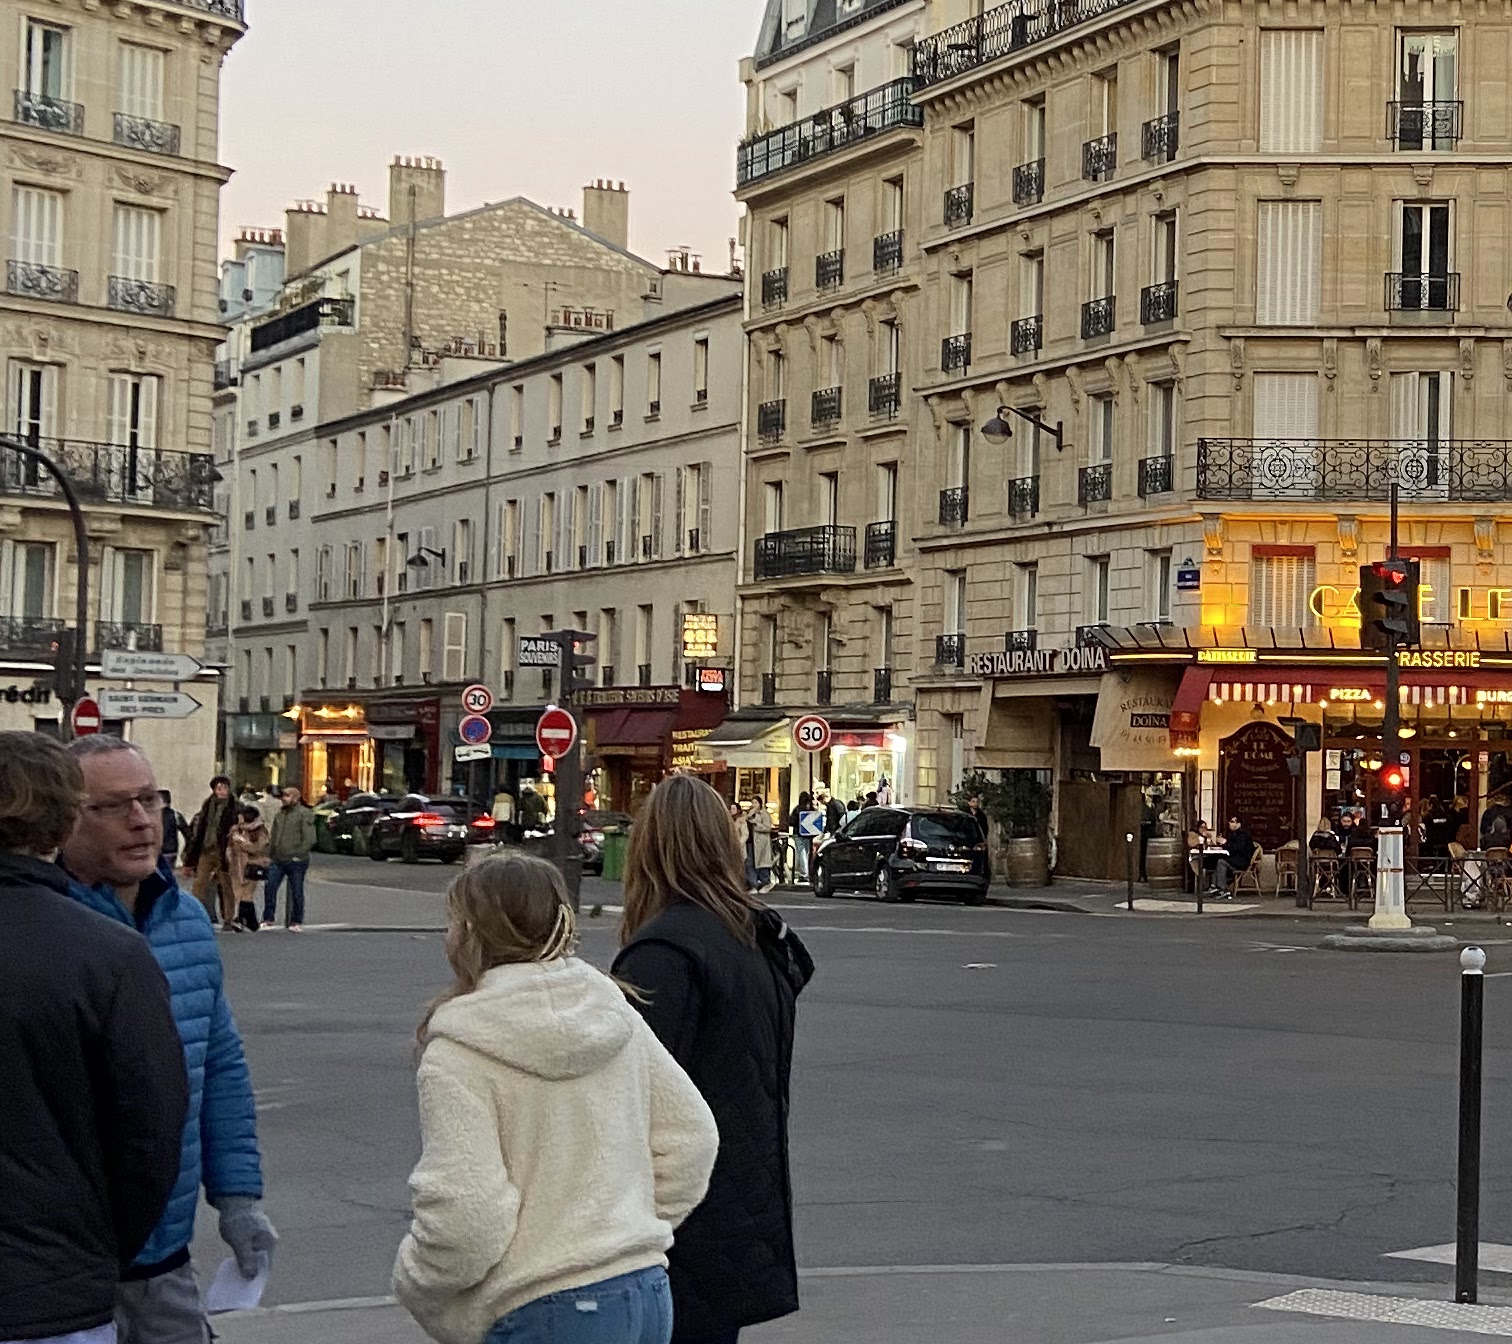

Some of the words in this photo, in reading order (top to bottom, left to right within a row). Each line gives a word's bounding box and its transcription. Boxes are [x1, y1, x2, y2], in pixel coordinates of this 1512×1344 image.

[520, 639, 558, 652] PARIS
[969, 650, 1052, 675] RESTAURANT
[1394, 651, 1481, 668] RASSERIE
[471, 693, 486, 706] 30
[1330, 688, 1371, 701] PIZZA
[672, 729, 714, 740] RESTAURA
[801, 726, 823, 742] 30
